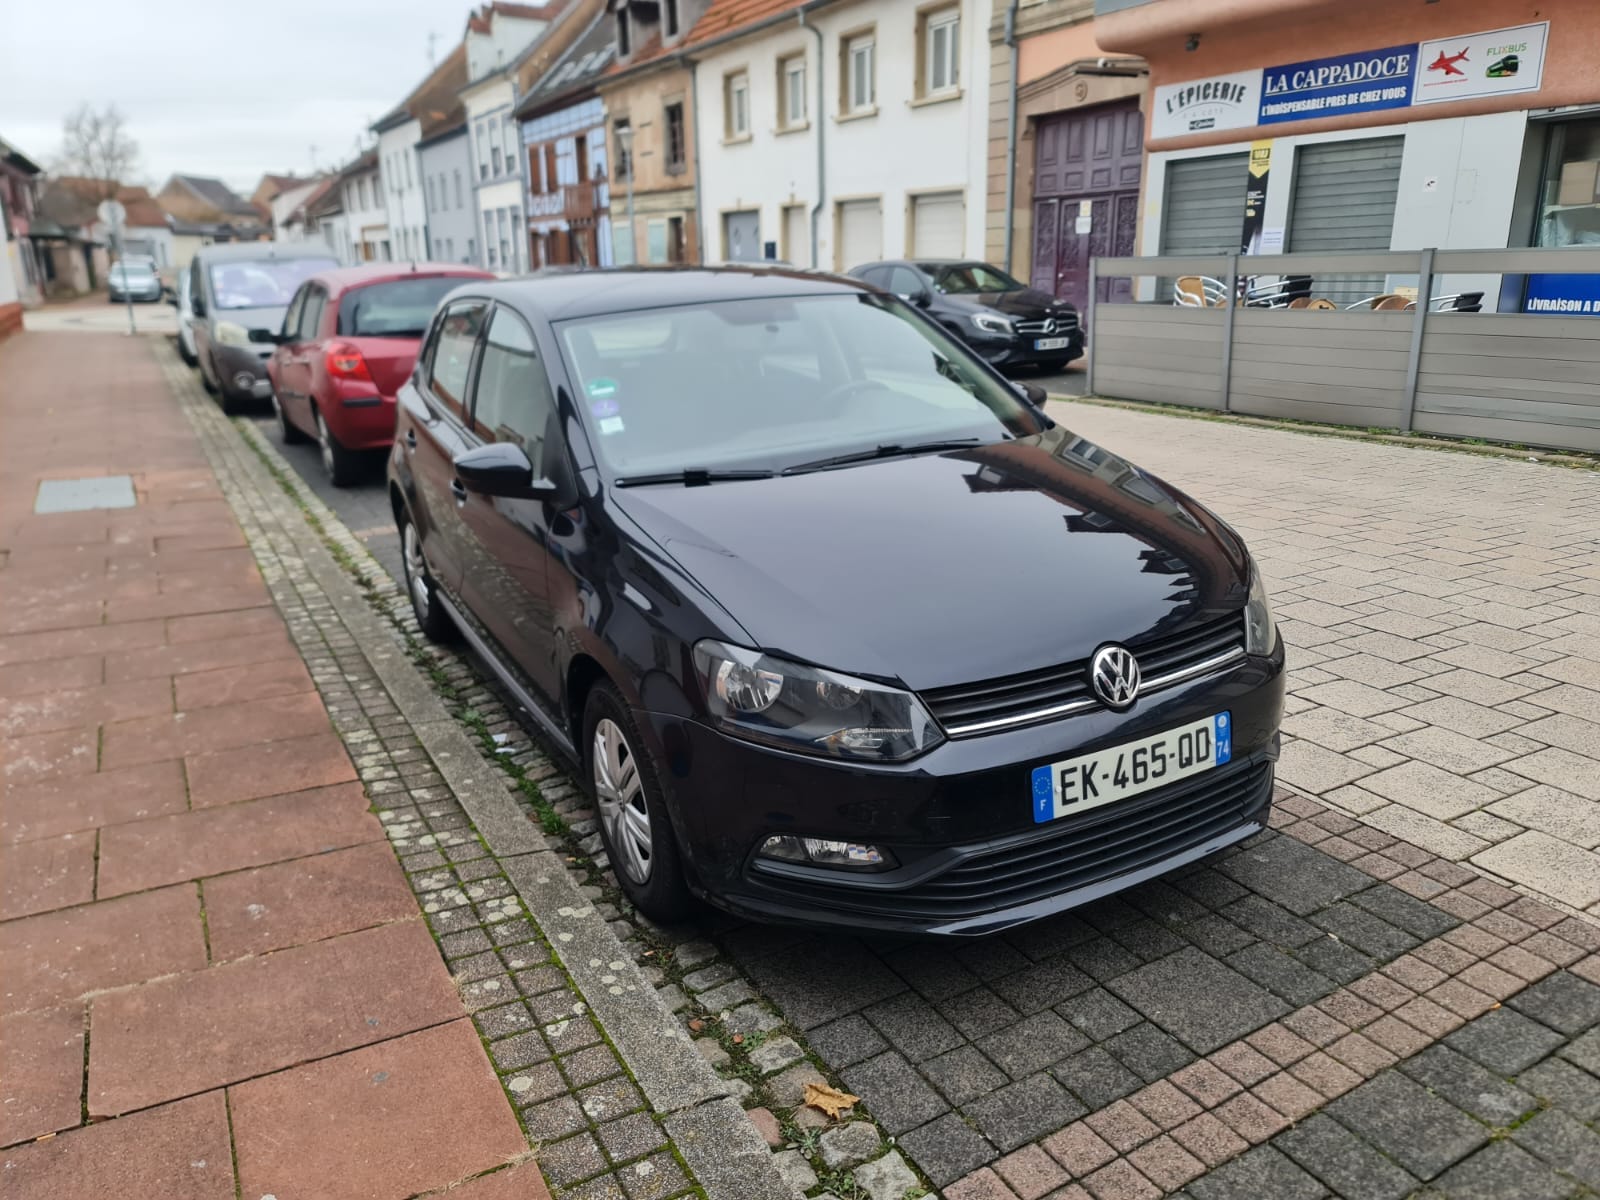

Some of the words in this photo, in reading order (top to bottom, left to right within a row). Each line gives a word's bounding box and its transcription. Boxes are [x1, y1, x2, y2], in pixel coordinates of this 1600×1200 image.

[1486, 42, 1528, 56] FLIXBUS
[1265, 73, 1289, 94] LA
[1292, 53, 1411, 90] CAPPADOCE
[1326, 93, 1347, 108] PRES
[1347, 92, 1359, 105] DE
[1359, 89, 1381, 104] CHEZ
[1382, 86, 1407, 101] VOUS
[1583, 300, 1592, 312] A
[1217, 739, 1229, 758] 74
[1060, 726, 1210, 806] EK-465-QD
[1040, 799, 1047, 811] F
